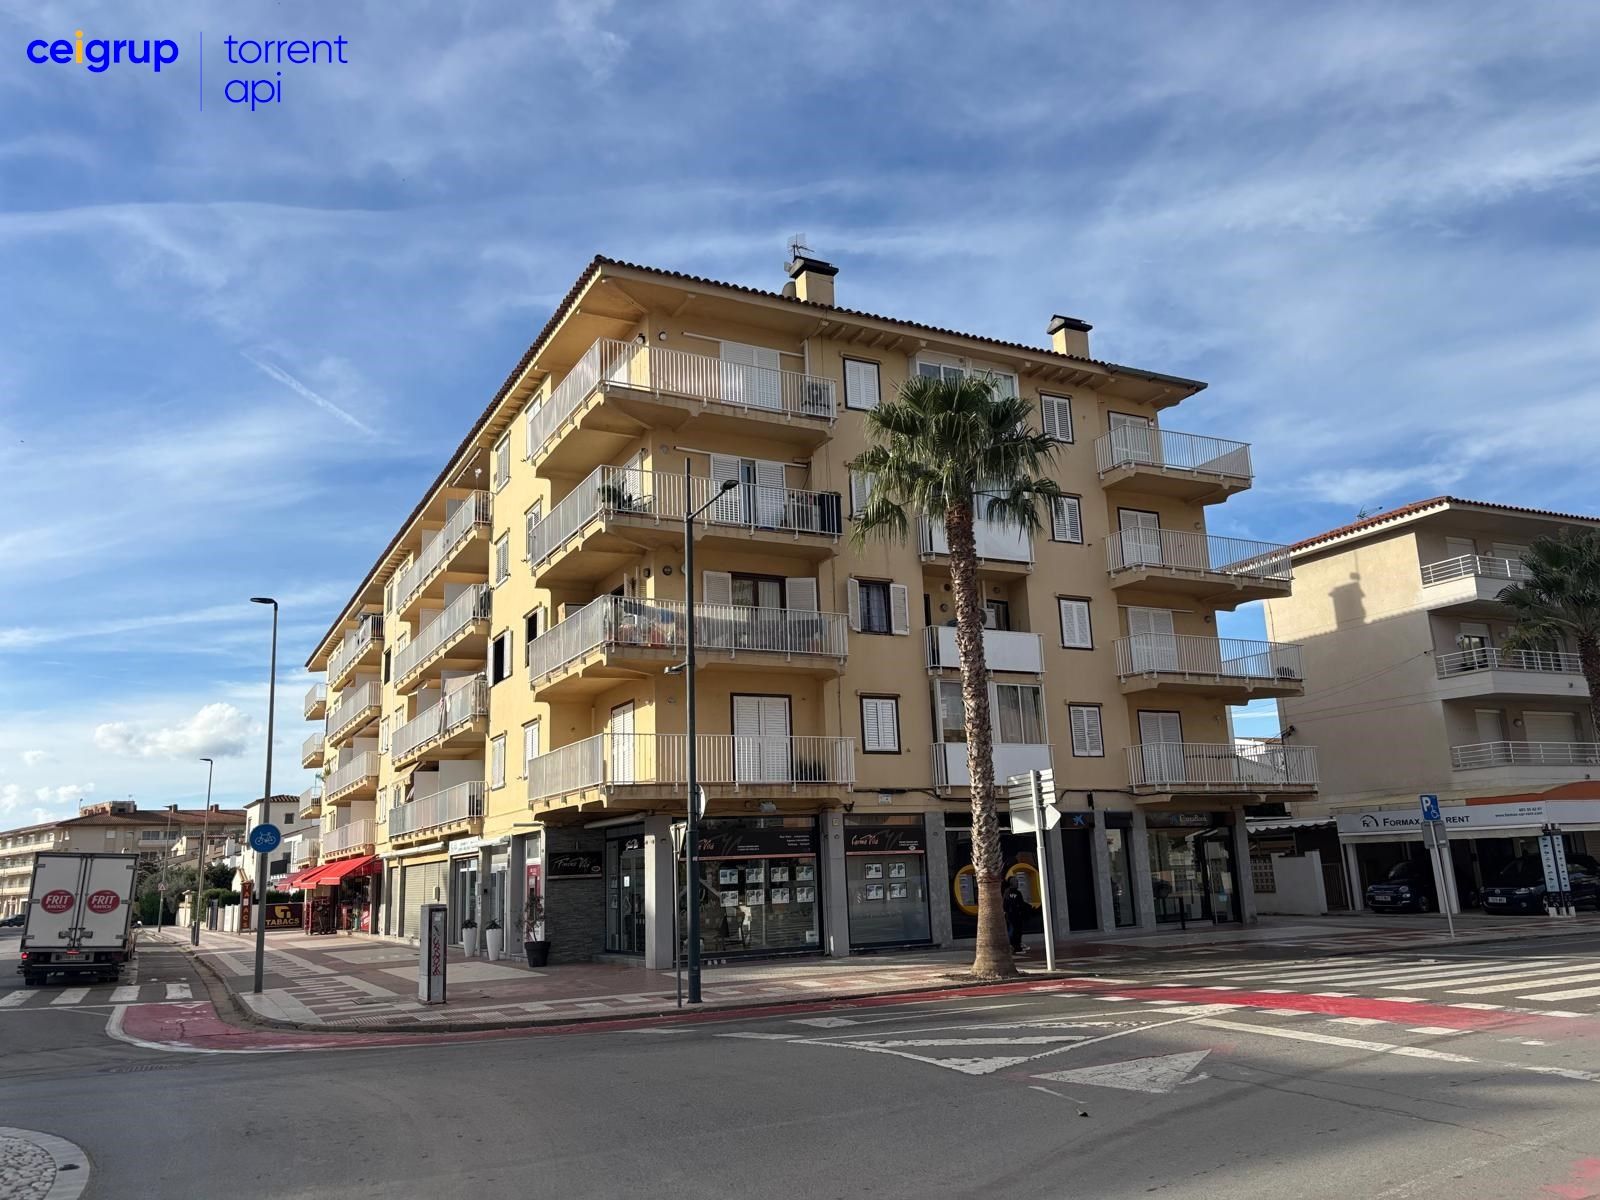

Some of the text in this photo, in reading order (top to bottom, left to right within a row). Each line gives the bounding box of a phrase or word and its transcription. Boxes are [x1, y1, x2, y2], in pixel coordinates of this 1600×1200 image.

[1421, 796, 1431, 812] P
[1445, 815, 1470, 824] RENT
[45, 895, 71, 905] FRIT
[91, 895, 117, 905] FRIT
[242, 884, 251, 928] TAACS
[266, 918, 300, 926] TABACS
